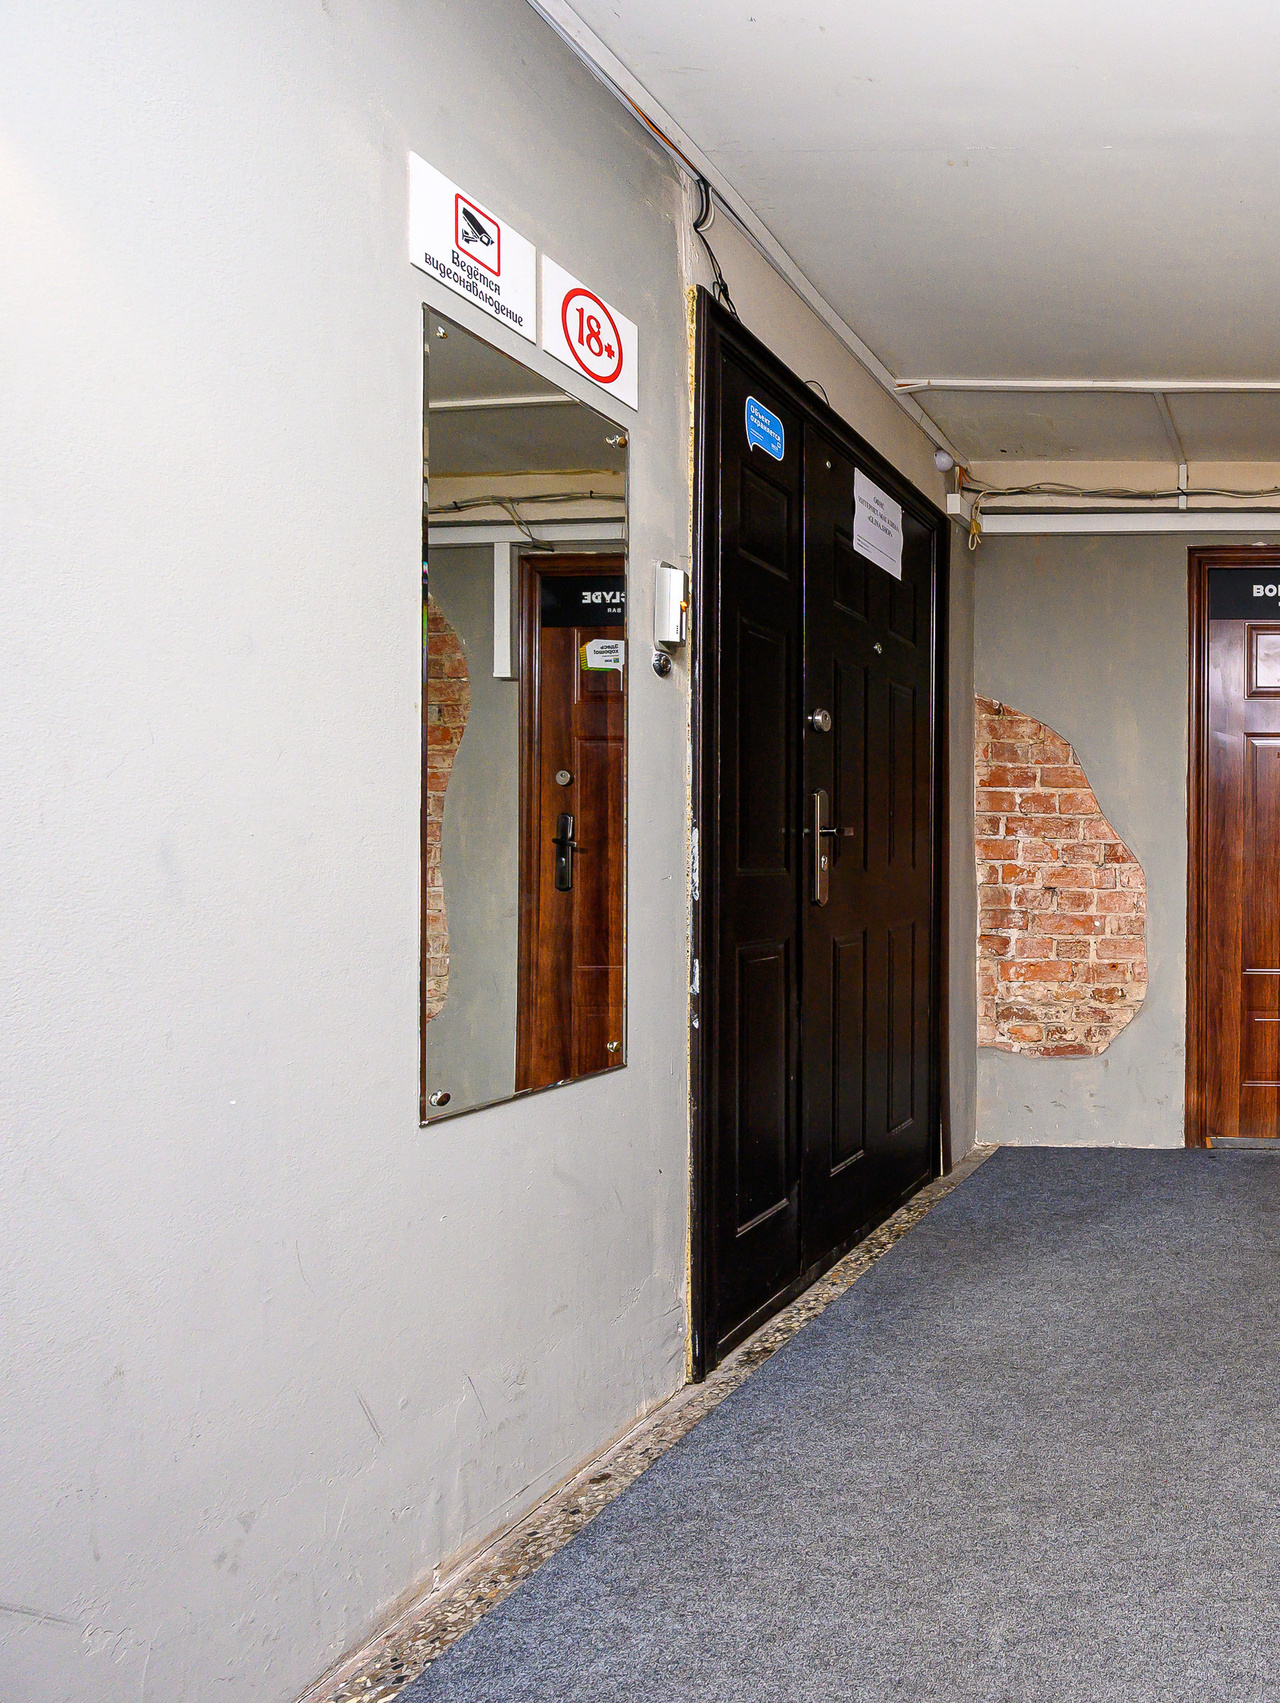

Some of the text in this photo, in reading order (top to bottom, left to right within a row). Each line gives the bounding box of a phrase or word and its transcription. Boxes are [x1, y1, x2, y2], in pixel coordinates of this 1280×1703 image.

[424, 252, 524, 327] видеонаблюдение
[451, 249, 501, 296] Ведётся
[576, 307, 616, 360] 18+
